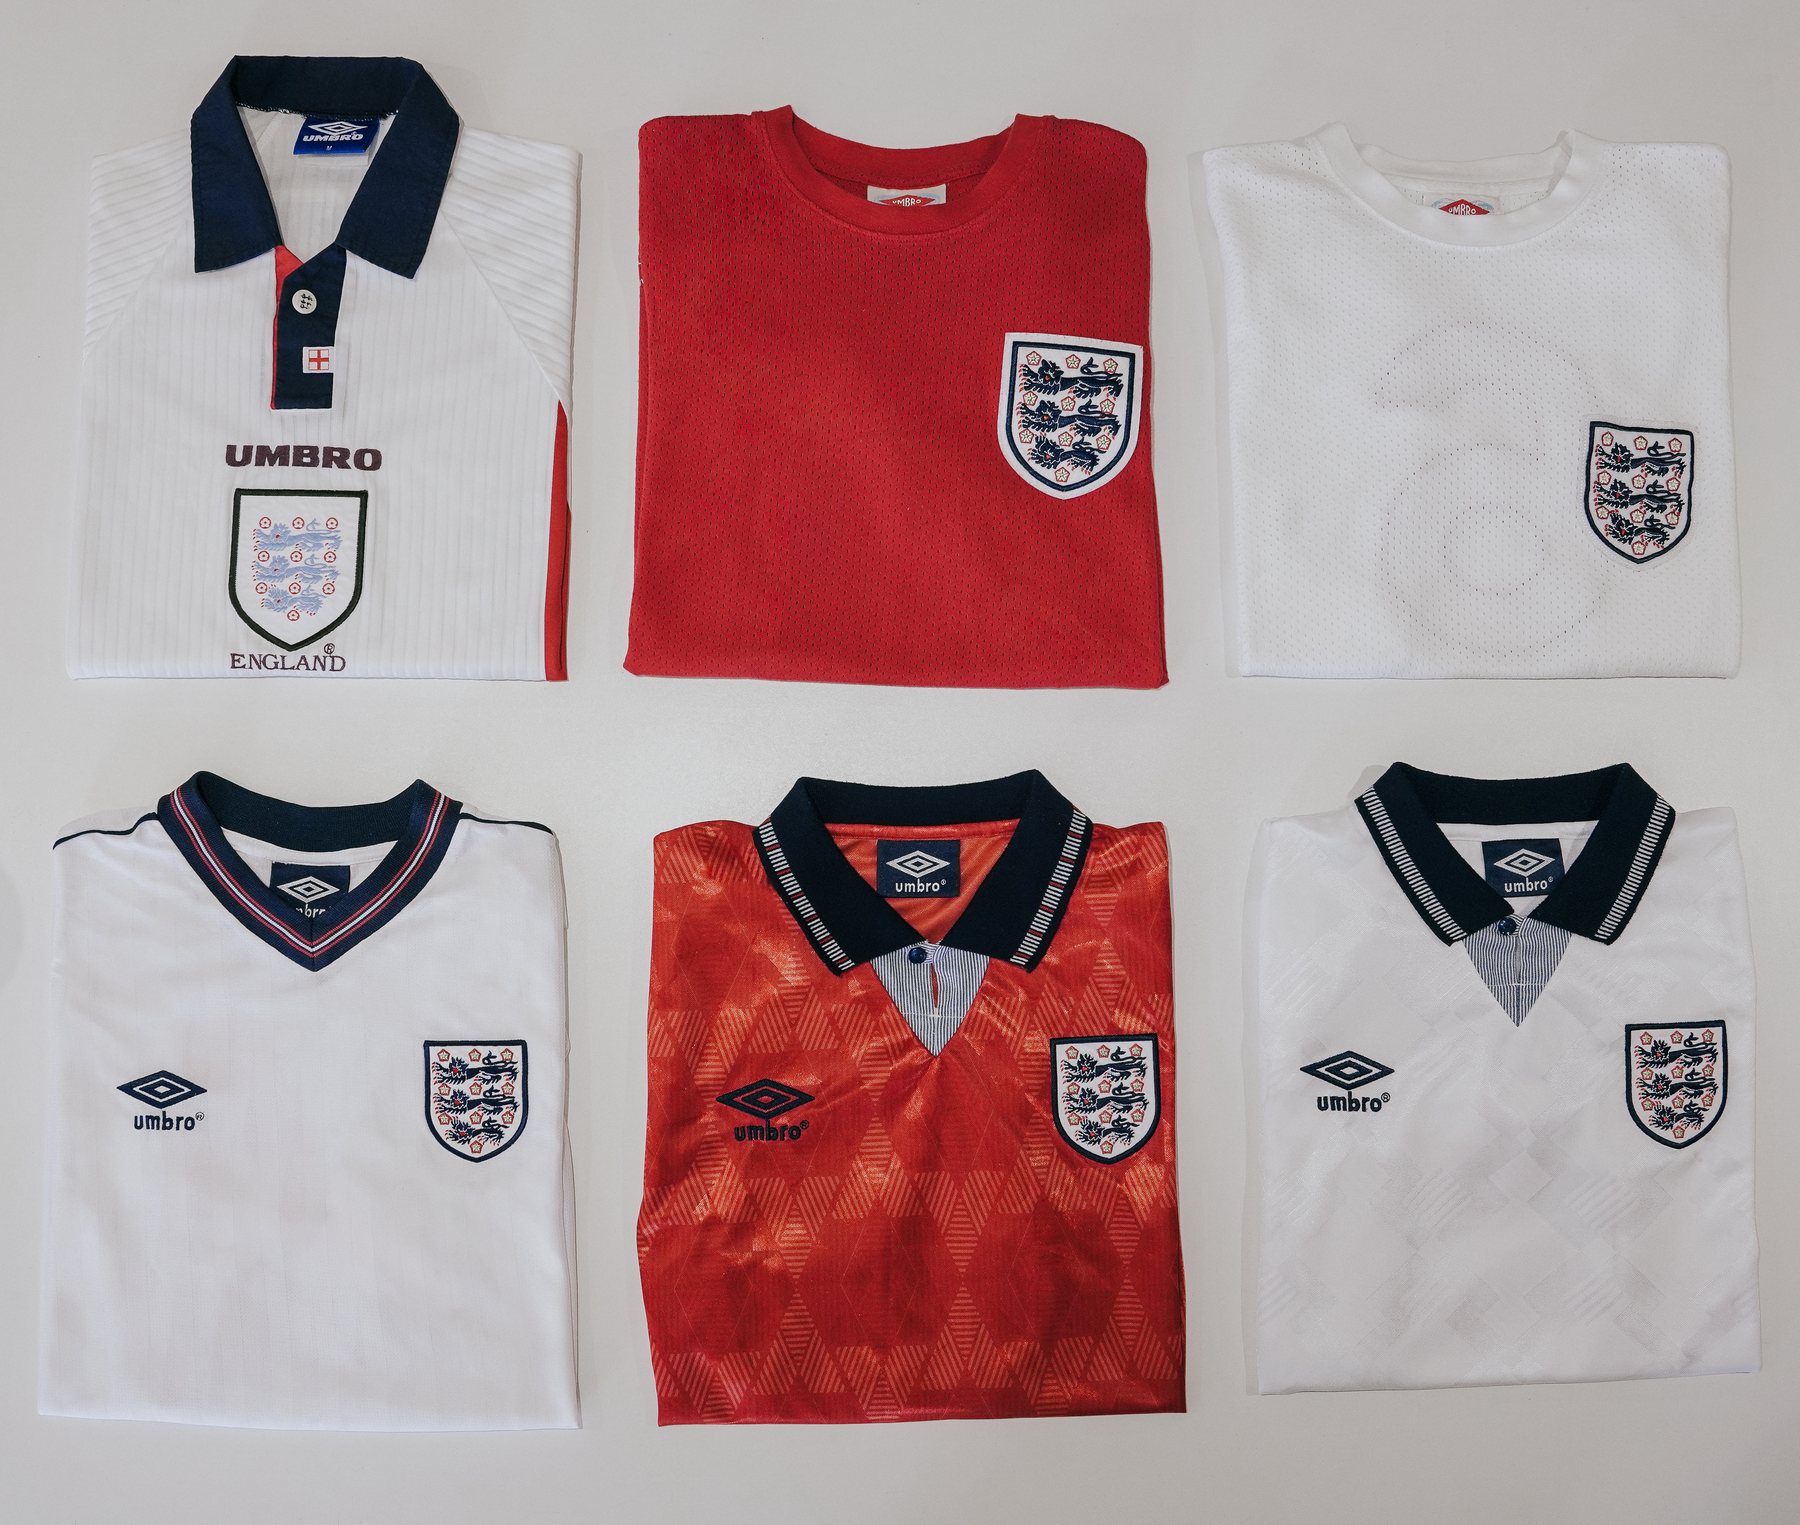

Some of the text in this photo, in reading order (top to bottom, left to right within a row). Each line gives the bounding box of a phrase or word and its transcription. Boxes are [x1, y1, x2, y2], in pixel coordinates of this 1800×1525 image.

[302, 133, 364, 142] UMBRO
[225, 444, 383, 471] UMBRO
[230, 652, 347, 672] ENGLAND
